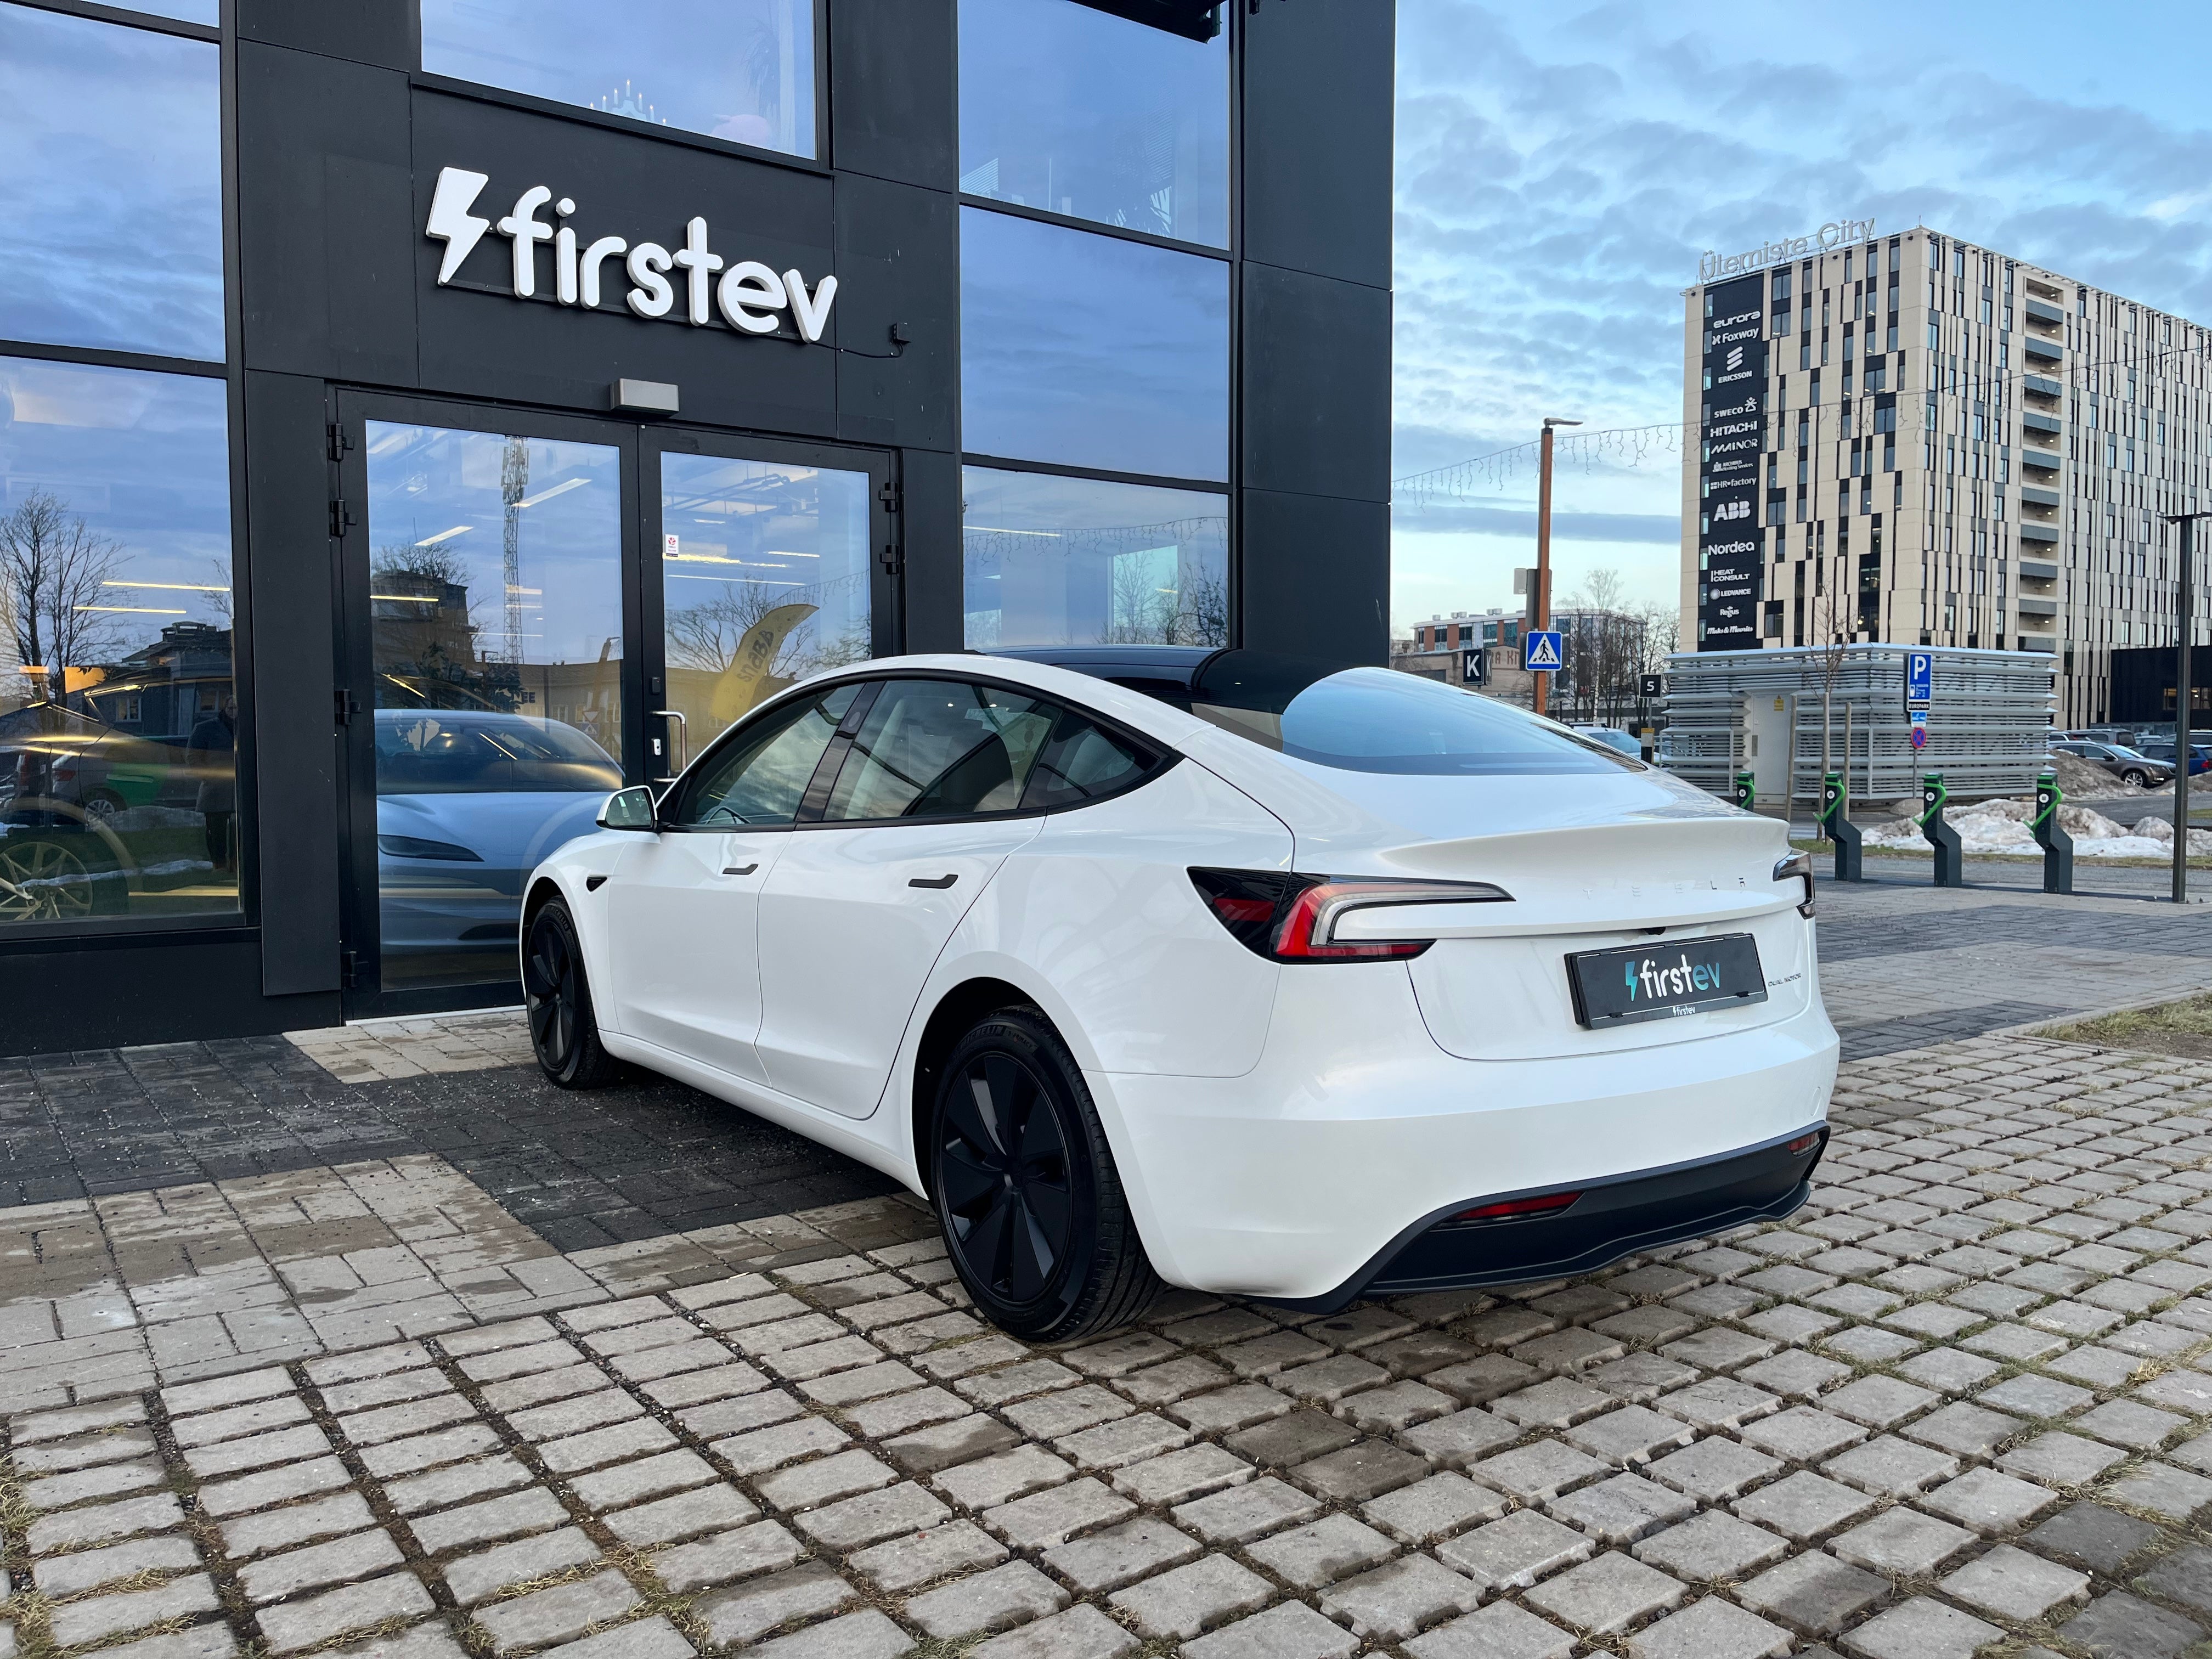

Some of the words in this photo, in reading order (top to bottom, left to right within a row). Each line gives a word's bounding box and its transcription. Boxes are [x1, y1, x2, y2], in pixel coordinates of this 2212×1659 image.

[1699, 237, 1808, 280] Ülemiste
[1816, 218, 1875, 248] City
[497, 185, 838, 342] firstev
[1713, 311, 1761, 329] eurora
[1722, 328, 1759, 343] Foxway
[1718, 370, 1753, 383] ERICSSON
[1714, 407, 1744, 419] SWECO
[1710, 420, 1758, 438] HITACHI
[1711, 438, 1758, 454] MAINOR
[1713, 500, 1751, 522] ABB
[1708, 541, 1755, 556] Nordea
[1713, 573, 1750, 582] CONSULT
[1721, 588, 1751, 597] LEDVANCE
[1720, 608, 1740, 618] Regus
[1466, 654, 1480, 677] K
[1914, 656, 1927, 680] P
[1646, 681, 1655, 691] 5
[1583, 877, 1746, 899] TESLA
[1640, 954, 1720, 998] firstev
[1677, 1005, 1695, 1016] firstev
